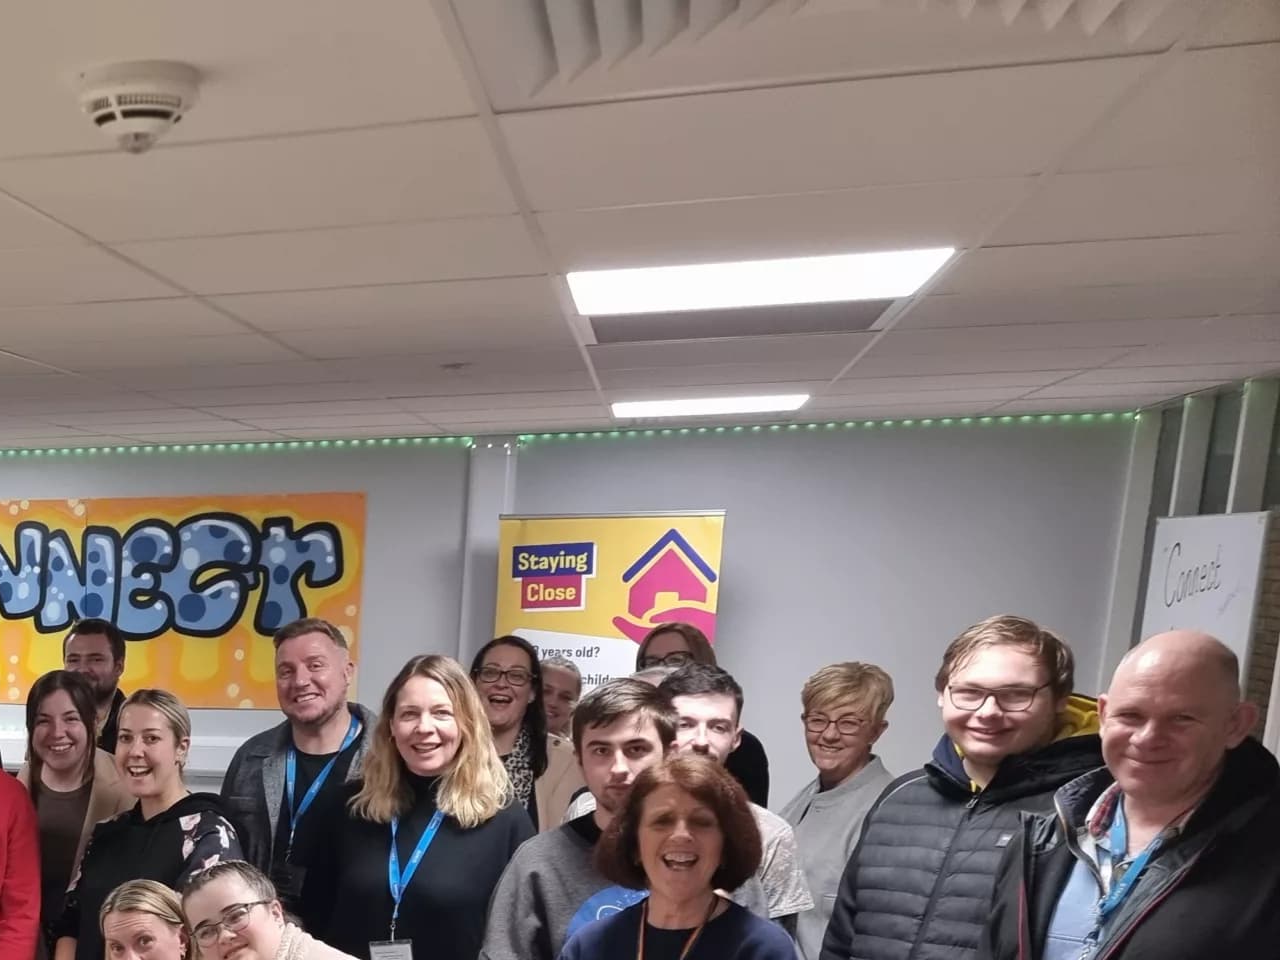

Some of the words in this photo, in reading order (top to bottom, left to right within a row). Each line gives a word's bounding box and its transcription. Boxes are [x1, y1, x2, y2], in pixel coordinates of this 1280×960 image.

[518, 550, 588, 574] Staying
[527, 583, 576, 602] Close
[541, 648, 573, 660] years
[575, 646, 600, 659] old?
